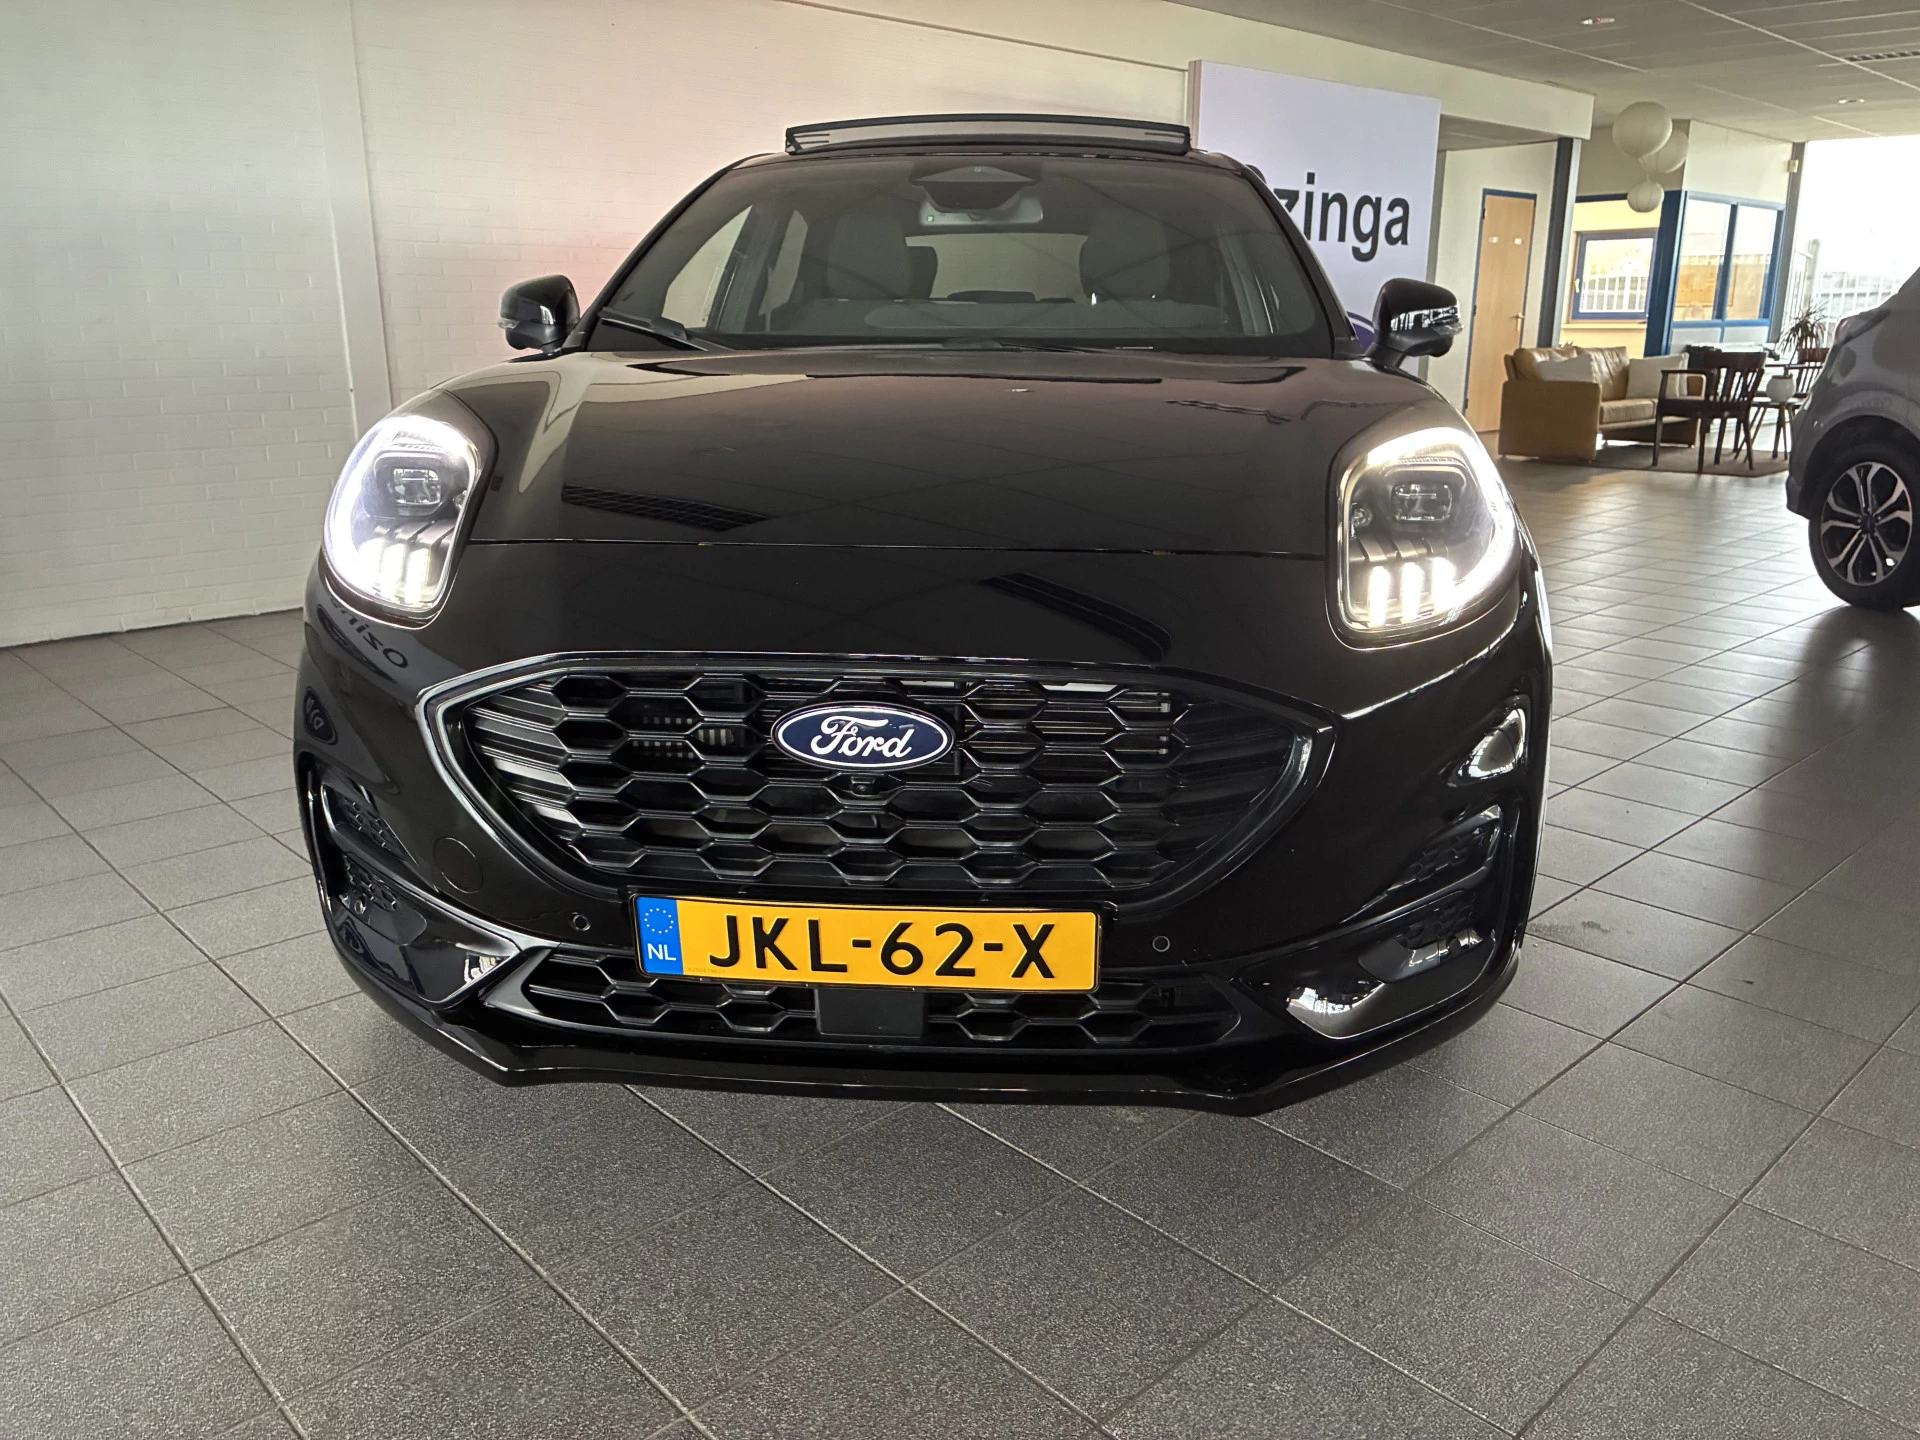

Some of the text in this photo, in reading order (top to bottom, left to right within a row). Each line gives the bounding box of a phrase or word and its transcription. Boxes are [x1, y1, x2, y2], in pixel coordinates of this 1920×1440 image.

[1246, 164, 1410, 262] zinga
[811, 715, 915, 758] Ford
[647, 943, 677, 961] NL
[709, 915, 1055, 979] JKL-62-X
